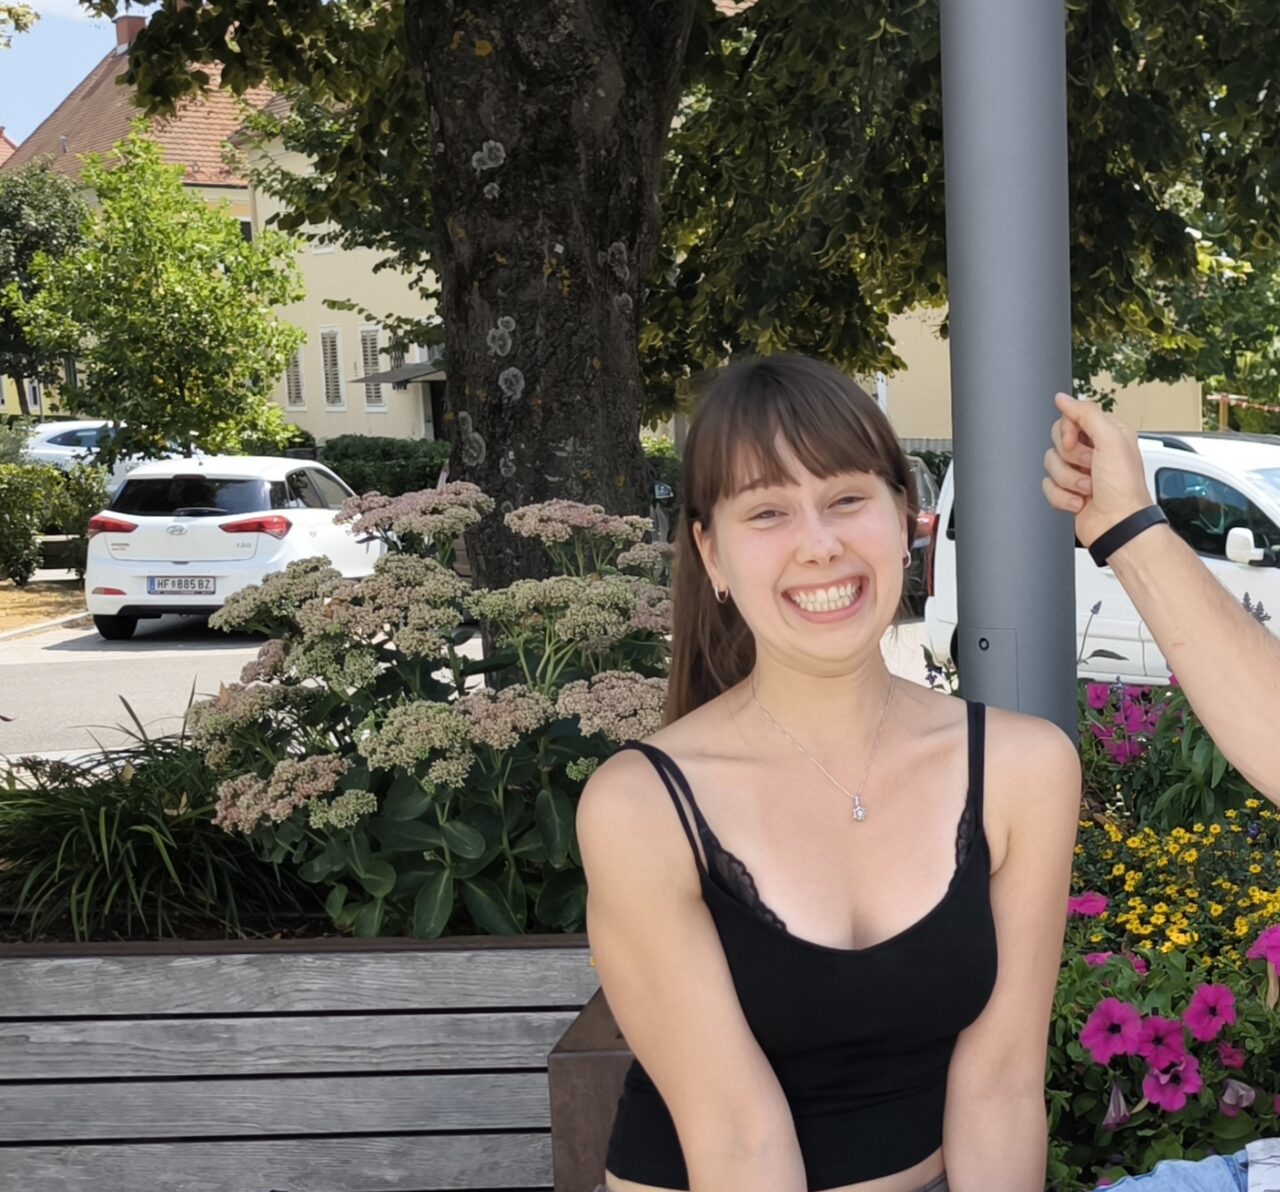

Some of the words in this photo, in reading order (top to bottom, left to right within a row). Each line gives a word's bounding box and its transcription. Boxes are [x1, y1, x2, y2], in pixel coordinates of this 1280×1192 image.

[157, 579, 170, 590] HF
[177, 579, 196, 590] 885
[197, 579, 211, 590] BZ
